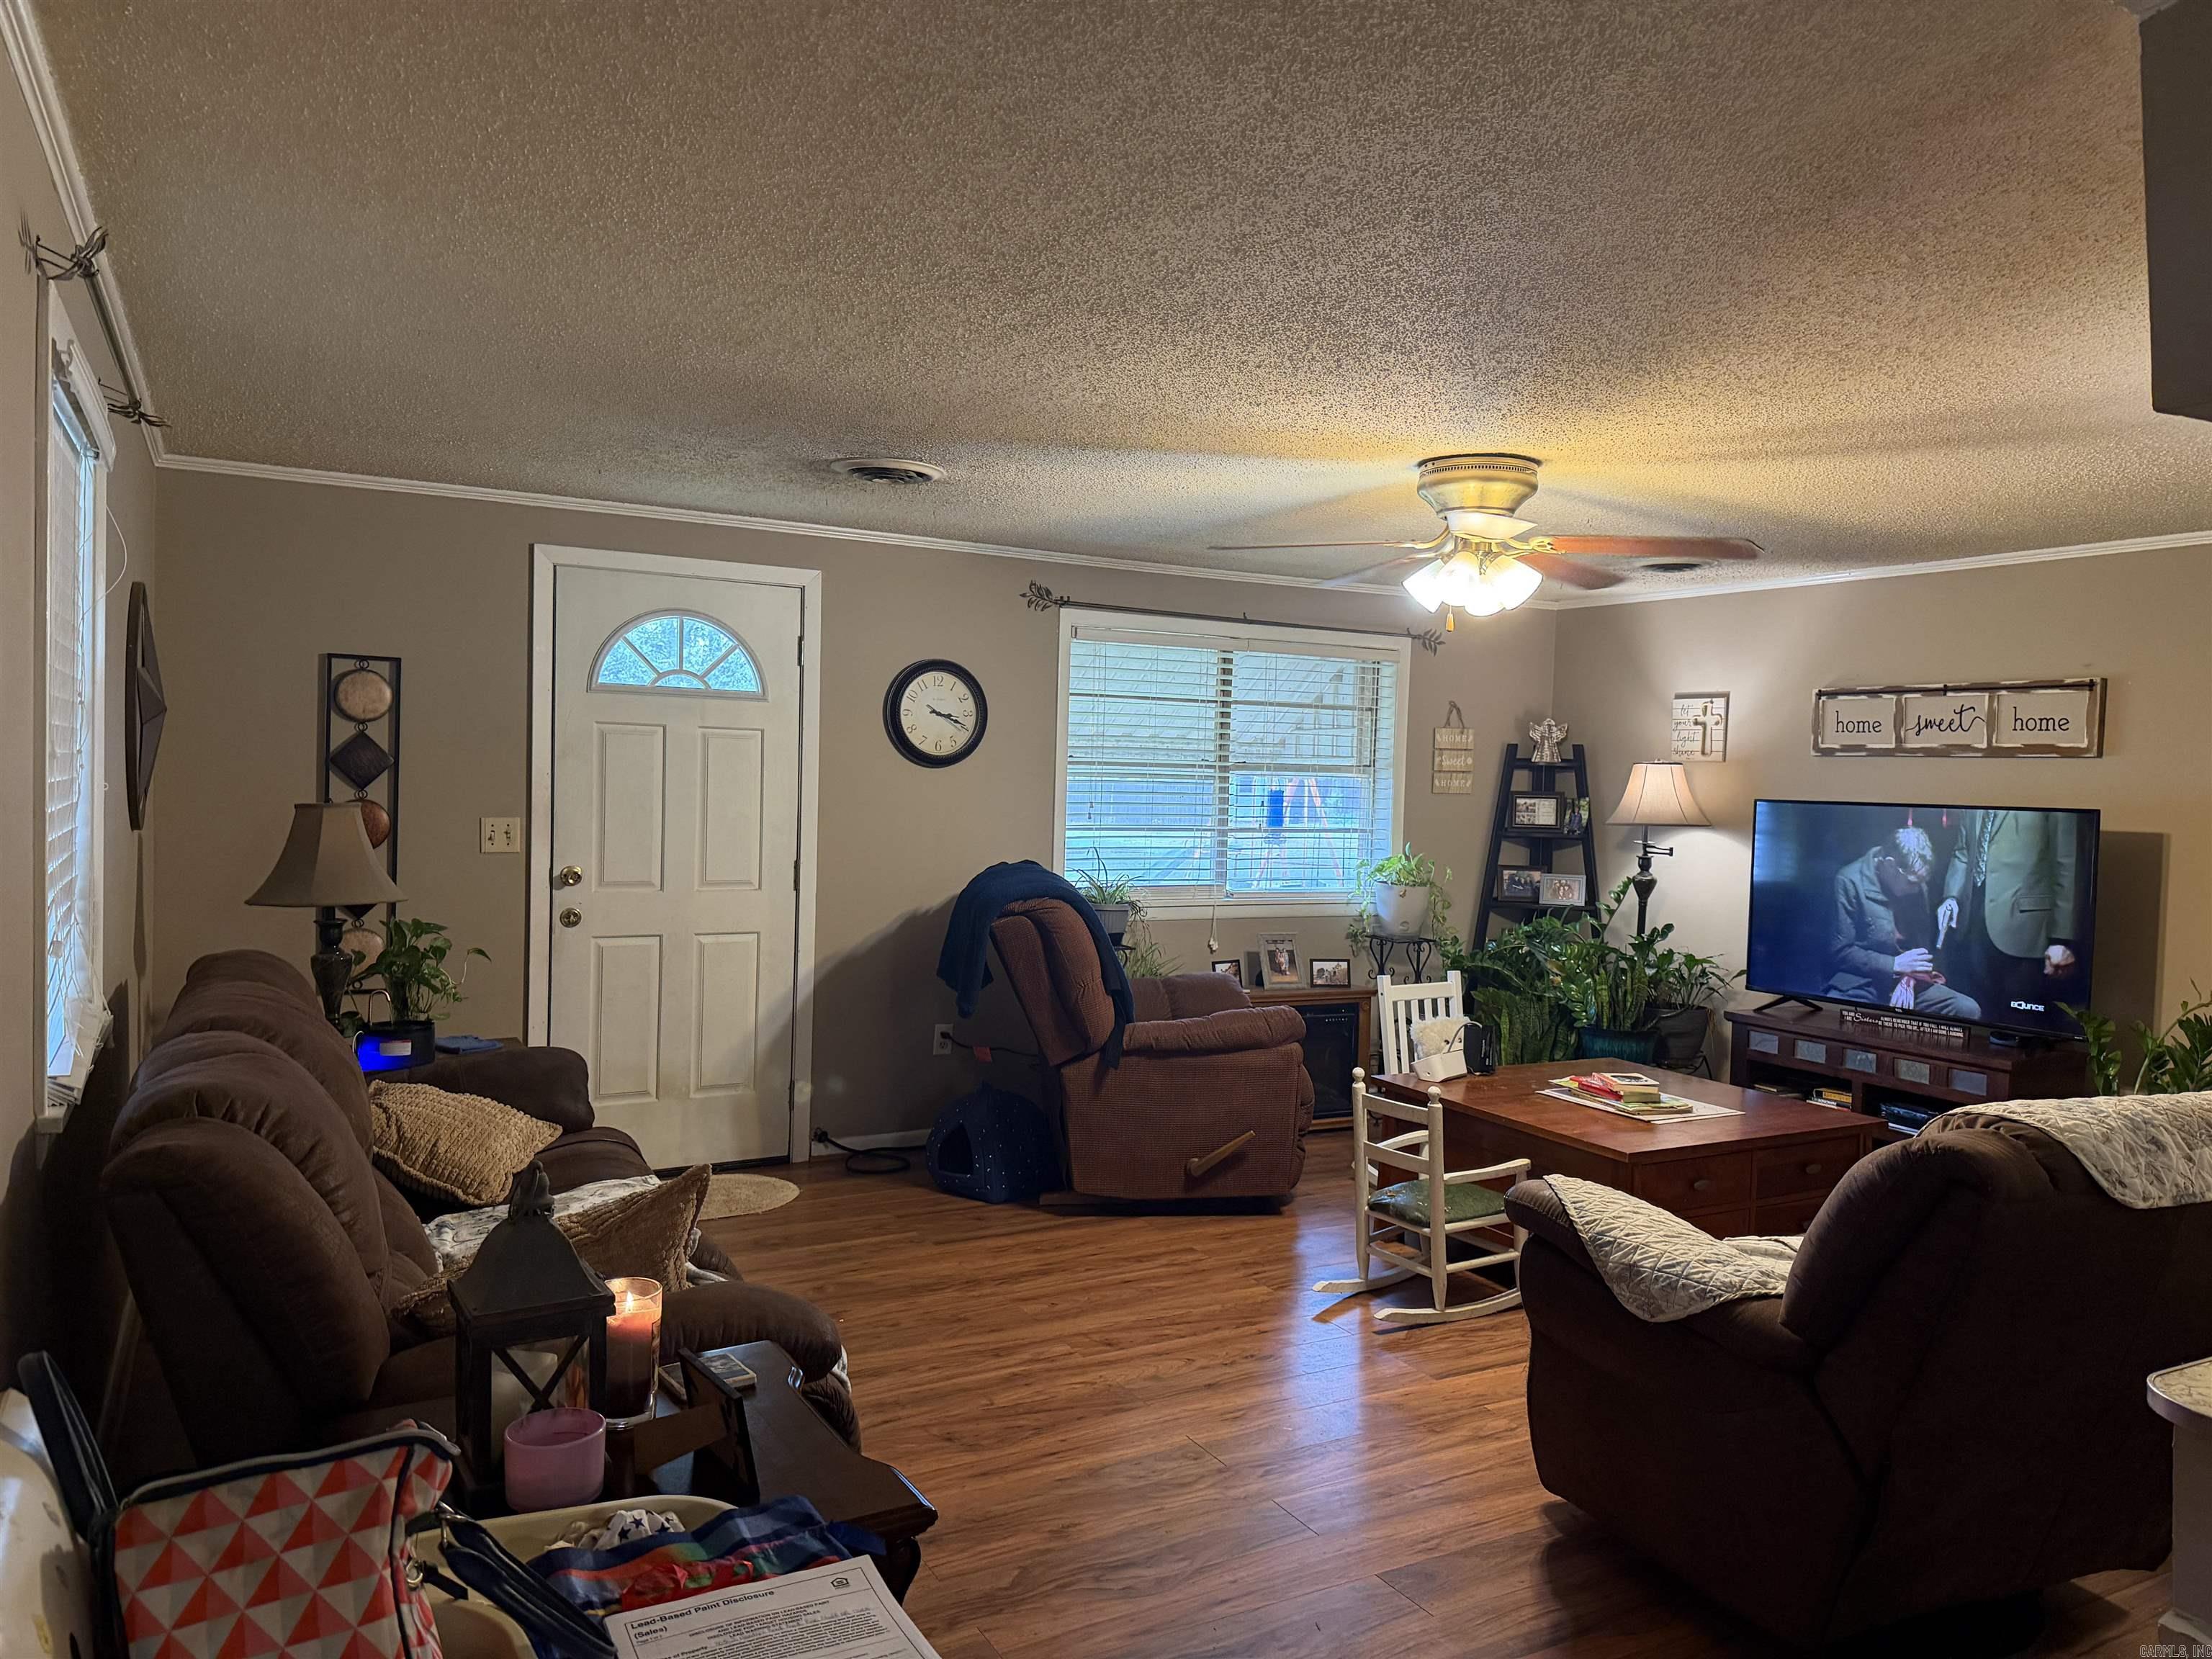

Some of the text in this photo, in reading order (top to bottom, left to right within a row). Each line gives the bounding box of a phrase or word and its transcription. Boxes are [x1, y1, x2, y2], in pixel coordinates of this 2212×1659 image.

[917, 679, 928, 692] 11
[932, 675, 944, 687] 12
[950, 681, 957, 691] 1
[906, 690, 919, 703] 10
[958, 693, 969, 703] 2
[902, 708, 913, 717] 9
[1672, 720, 1692, 732] your
[1835, 703, 2070, 737] home sweet home
[906, 723, 917, 734] 8
[918, 735, 928, 746] 7
[950, 735, 957, 748] 5
[1676, 731, 1699, 747] light
[935, 739, 942, 752] 6
[1441, 754, 1465, 767] Sweet
[1440, 779, 1466, 788] HOME
[2010, 1001, 2045, 1012] BOUNCE
[631, 1590, 775, 1629] Lead-Based Paint Disclosure
[634, 1625, 667, 1640] (Sales)
